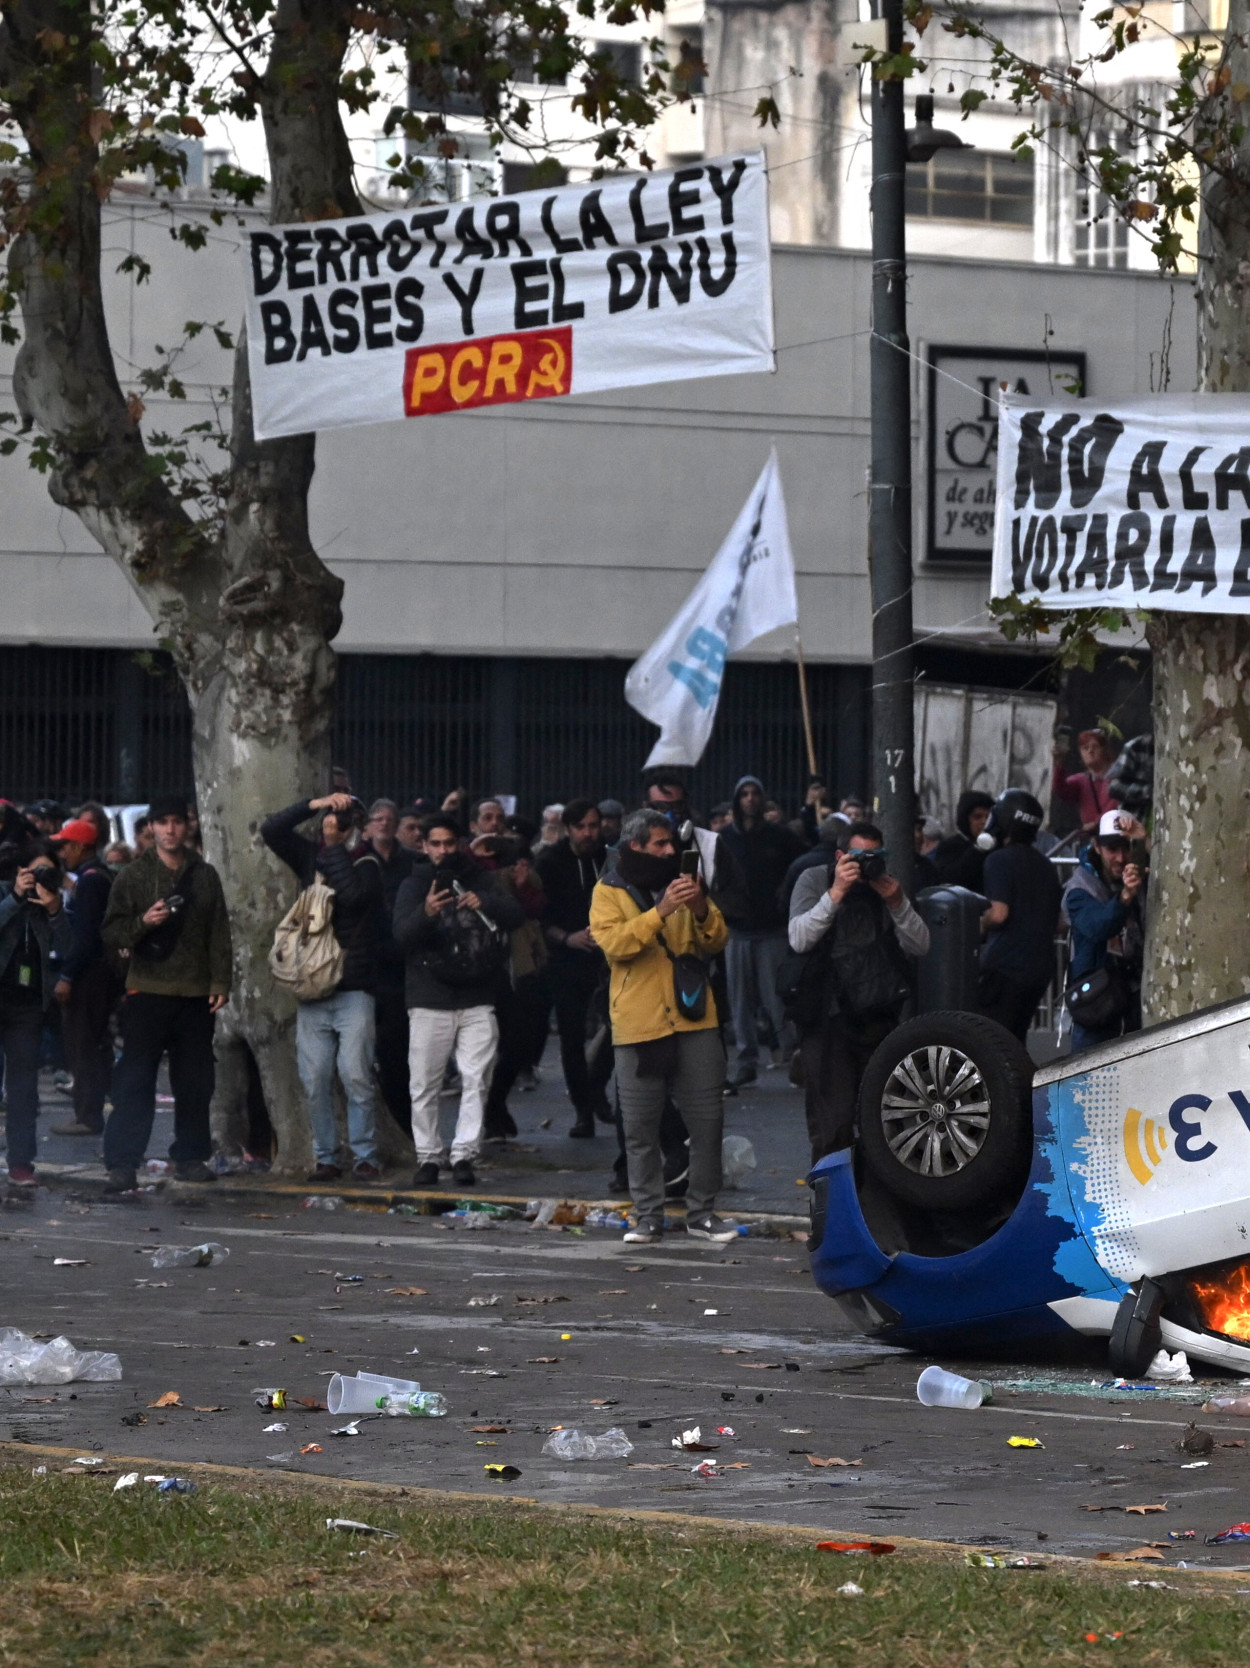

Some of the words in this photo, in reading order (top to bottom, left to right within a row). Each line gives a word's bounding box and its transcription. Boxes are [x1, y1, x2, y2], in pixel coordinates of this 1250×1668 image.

[250, 200, 533, 296] DERROTAR
[541, 188, 618, 255] LA
[629, 158, 747, 244] LEY
[260, 276, 425, 366] BASES
[442, 267, 484, 336] Y
[513, 257, 584, 330] EL
[608, 232, 738, 314] DNU
[411, 340, 523, 408] PCR
[945, 477, 968, 504] de
[1014, 410, 1125, 511] NO
[1126, 440, 1170, 511] A
[944, 510, 958, 536] y
[885, 749, 905, 768] 17
[889, 775, 896, 794] 1
[1168, 1093, 1218, 1163] 3
